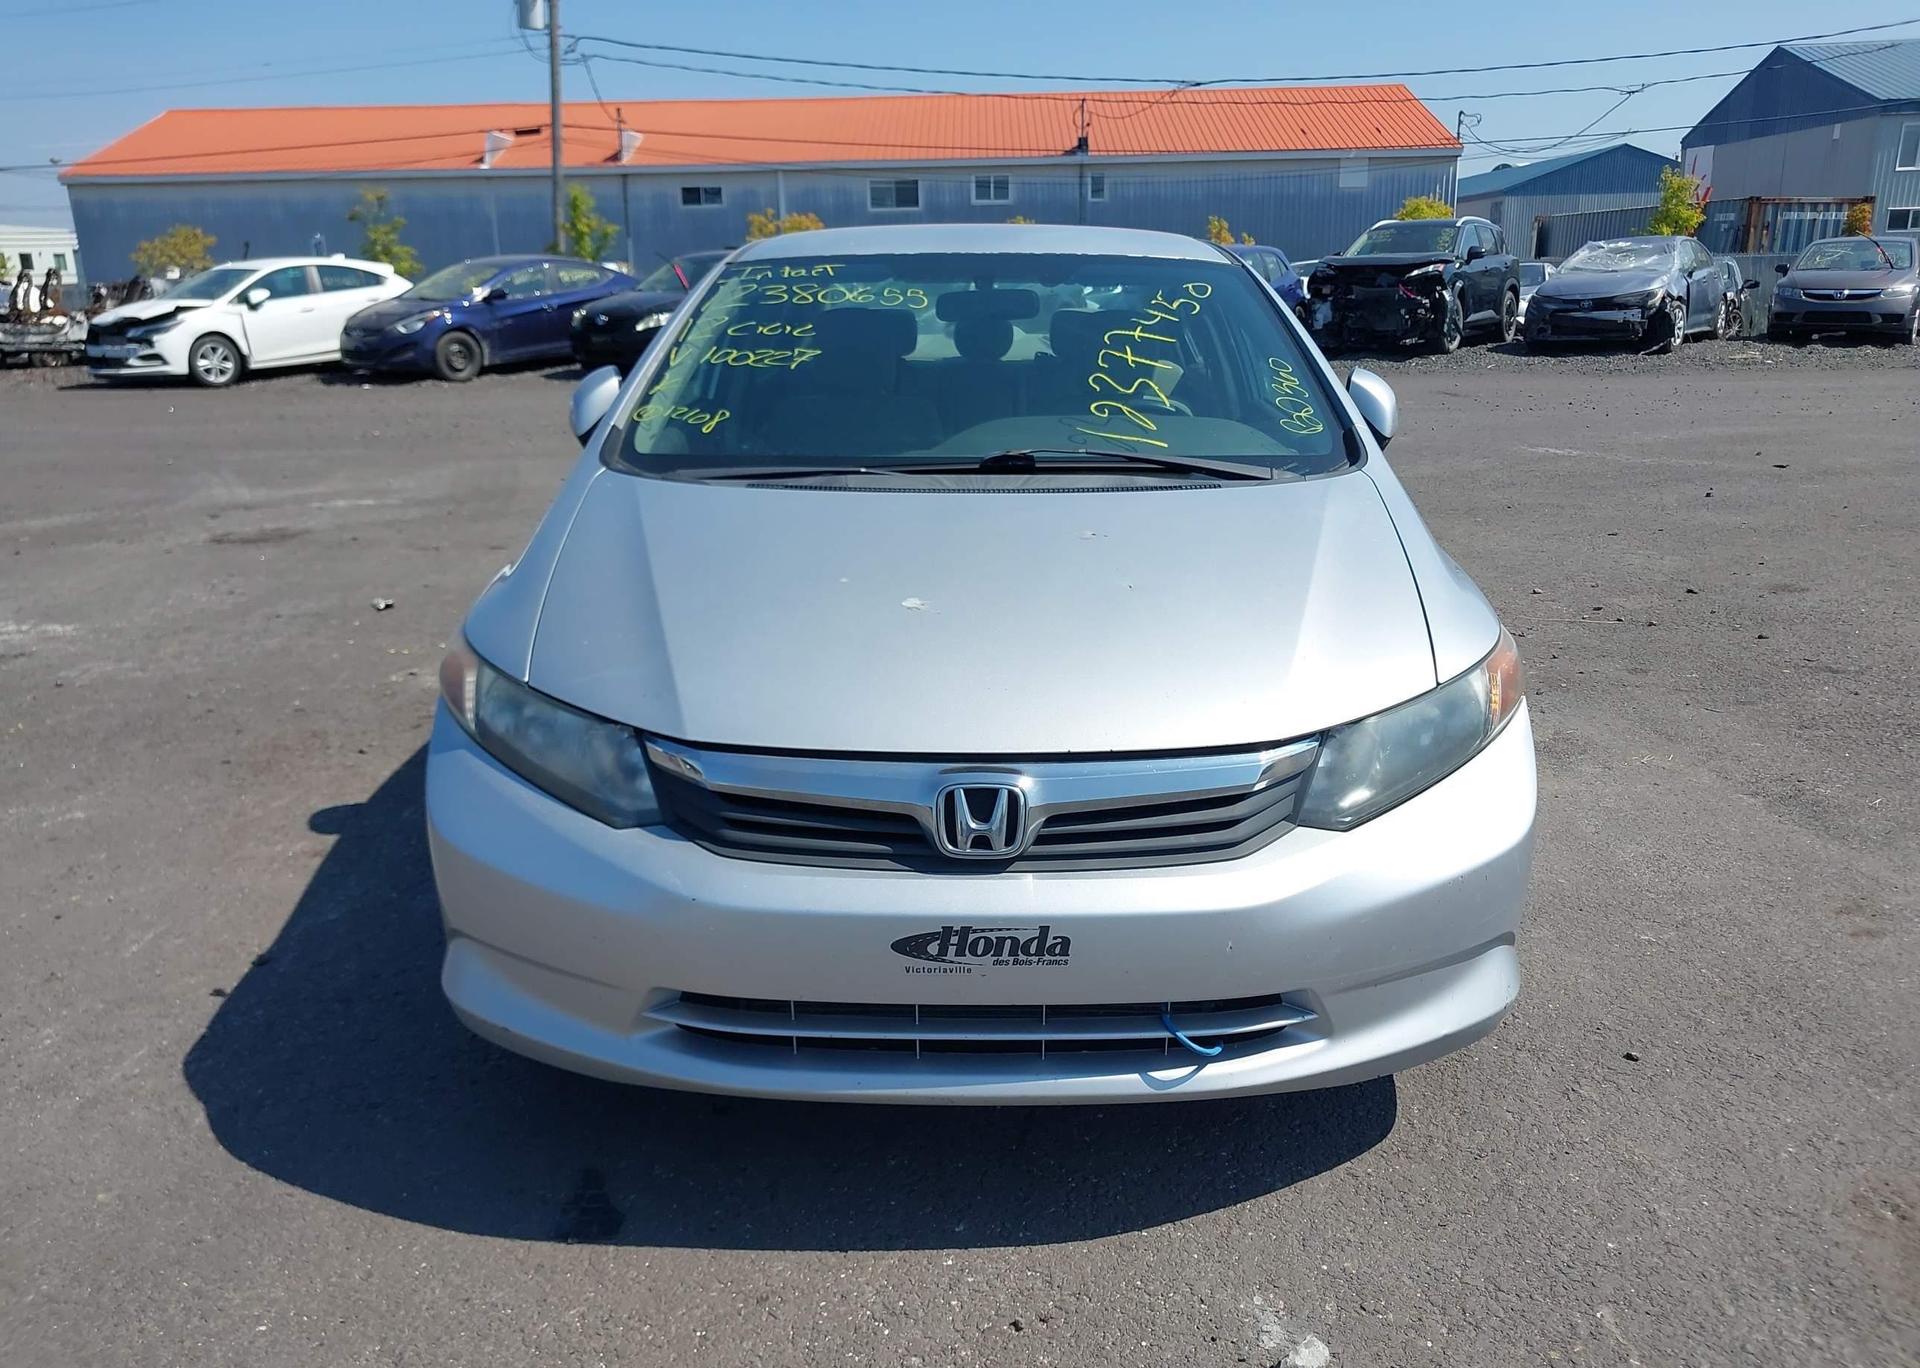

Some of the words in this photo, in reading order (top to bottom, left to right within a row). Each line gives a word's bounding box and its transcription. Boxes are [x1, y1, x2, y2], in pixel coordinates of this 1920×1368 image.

[935, 925, 1072, 957] Honda
[992, 958, 1009, 966] des
[1012, 957, 1069, 966] Bois-Francs
[904, 966, 972, 974] Victoriaville
